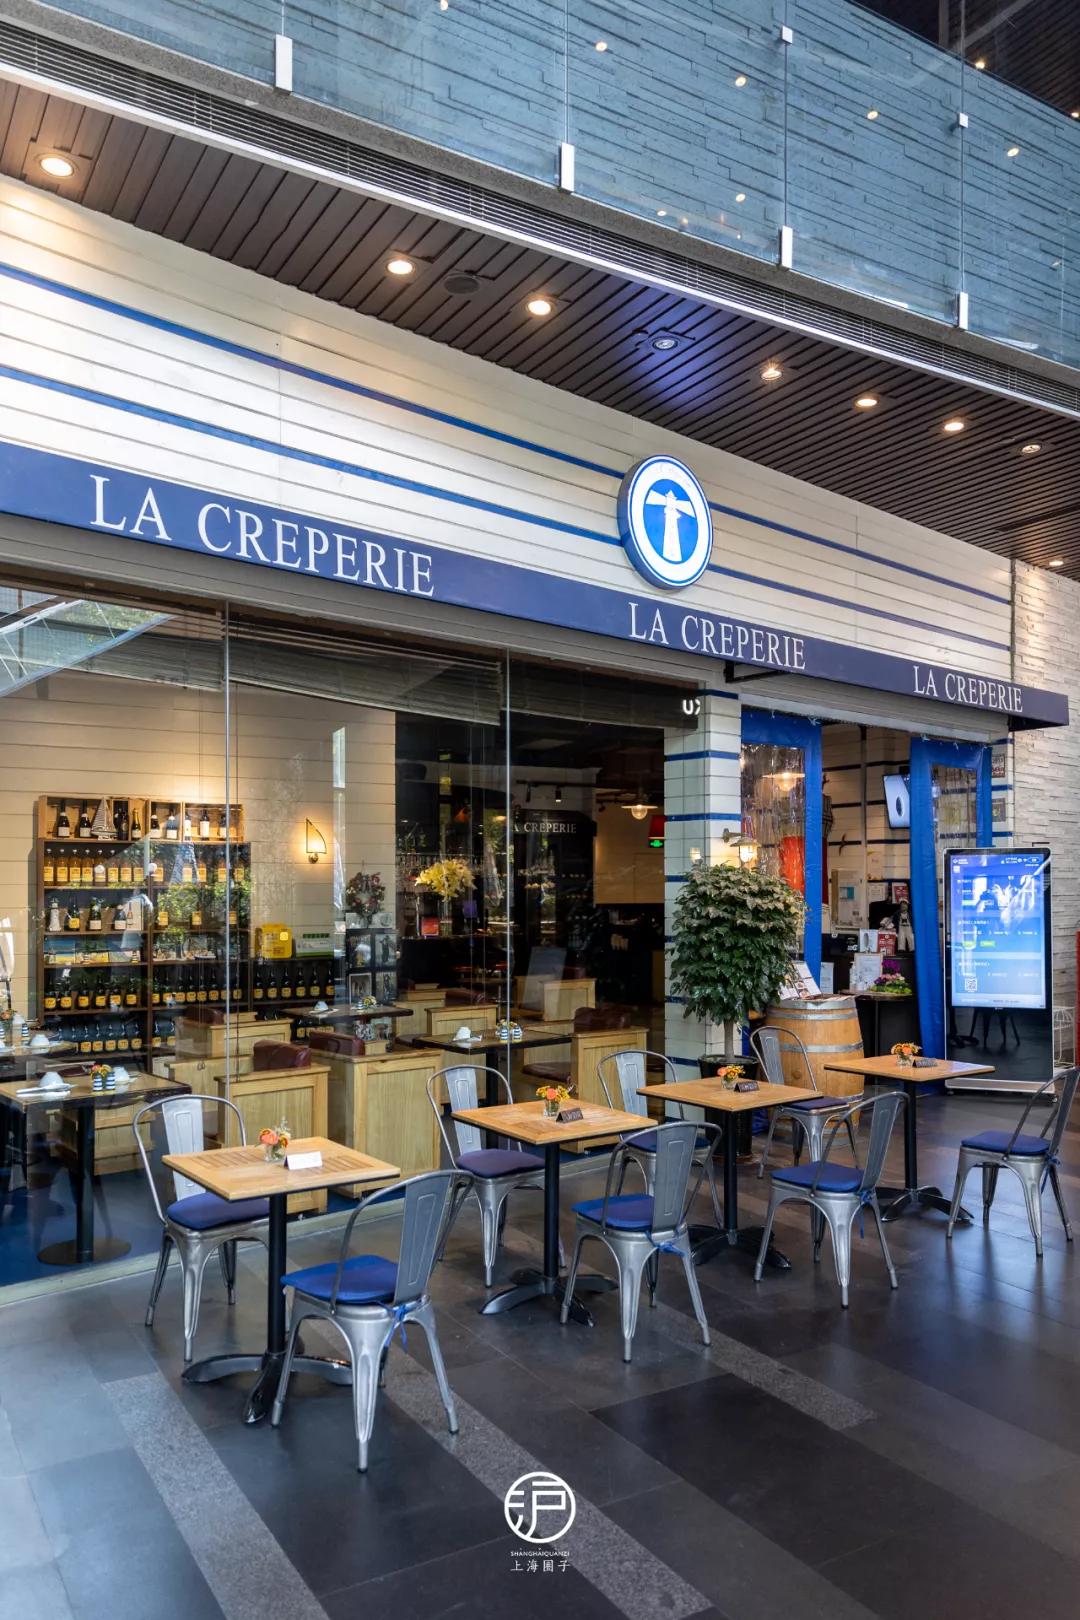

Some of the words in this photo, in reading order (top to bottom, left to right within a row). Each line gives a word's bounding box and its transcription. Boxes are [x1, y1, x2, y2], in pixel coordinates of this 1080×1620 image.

[89, 474, 172, 541] LA
[197, 502, 434, 597] CREPERIE
[628, 602, 669, 645] LA
[681, 614, 806, 670] CREPERIE
[913, 665, 939, 697] LA
[944, 673, 1023, 713] CREPERIE
[523, 822, 577, 834] CREPERIE
